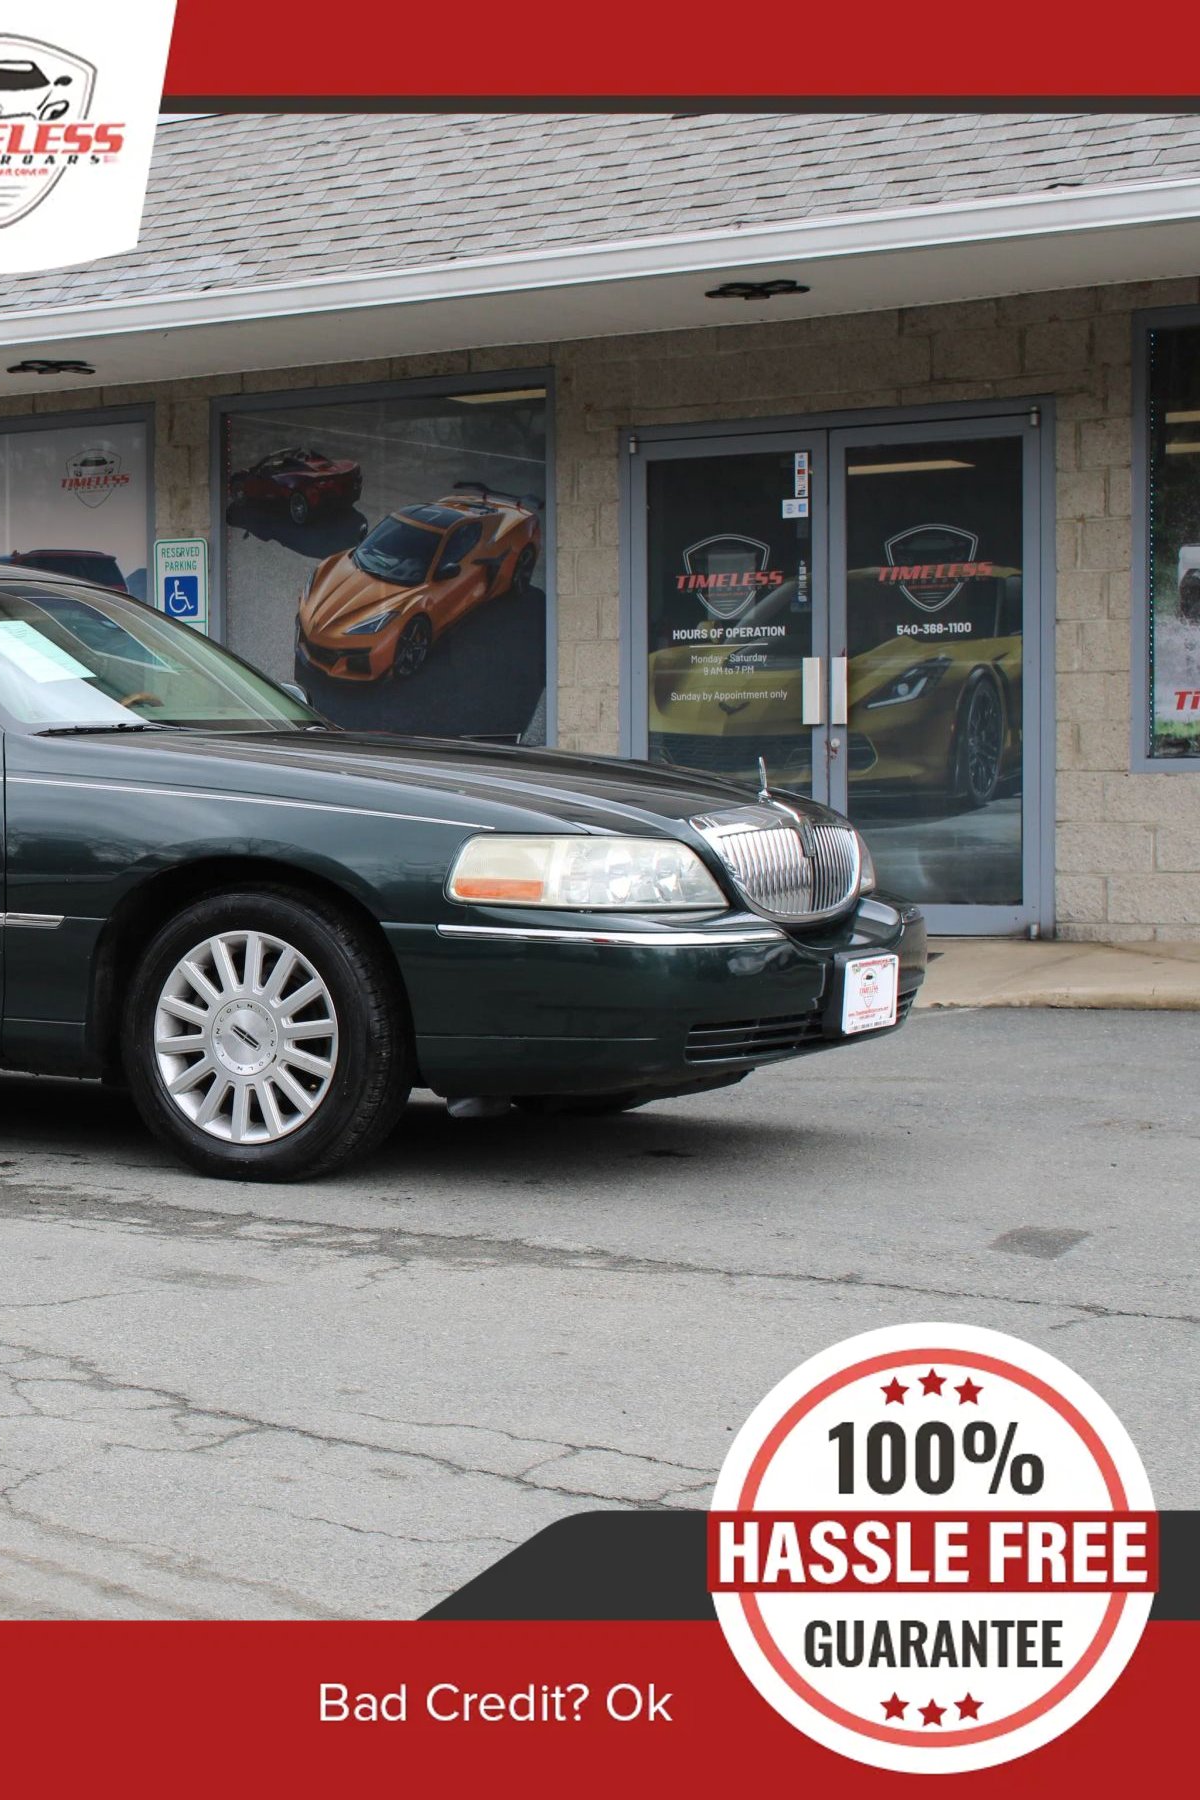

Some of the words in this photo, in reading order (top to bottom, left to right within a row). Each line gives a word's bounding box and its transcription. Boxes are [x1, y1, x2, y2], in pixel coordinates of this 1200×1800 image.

[61, 473, 130, 489] TIMELESS
[161, 547, 200, 558] RESERVED
[164, 561, 197, 571] PARKING
[878, 561, 992, 582] TIMELESS
[675, 570, 784, 589] TIMELESS
[672, 628, 707, 640] HOURS
[710, 628, 723, 638] OF
[725, 626, 786, 638] OPERATION
[896, 622, 972, 635] 540-368-1100
[691, 654, 722, 664] Monday
[730, 653, 767, 663] Saturday
[710, 667, 723, 676] AM
[725, 667, 733, 675] to
[741, 665, 754, 674] PM
[671, 692, 700, 703] Sunday
[702, 692, 713, 702] by
[714, 691, 768, 701] Appointment
[770, 689, 788, 700] only
